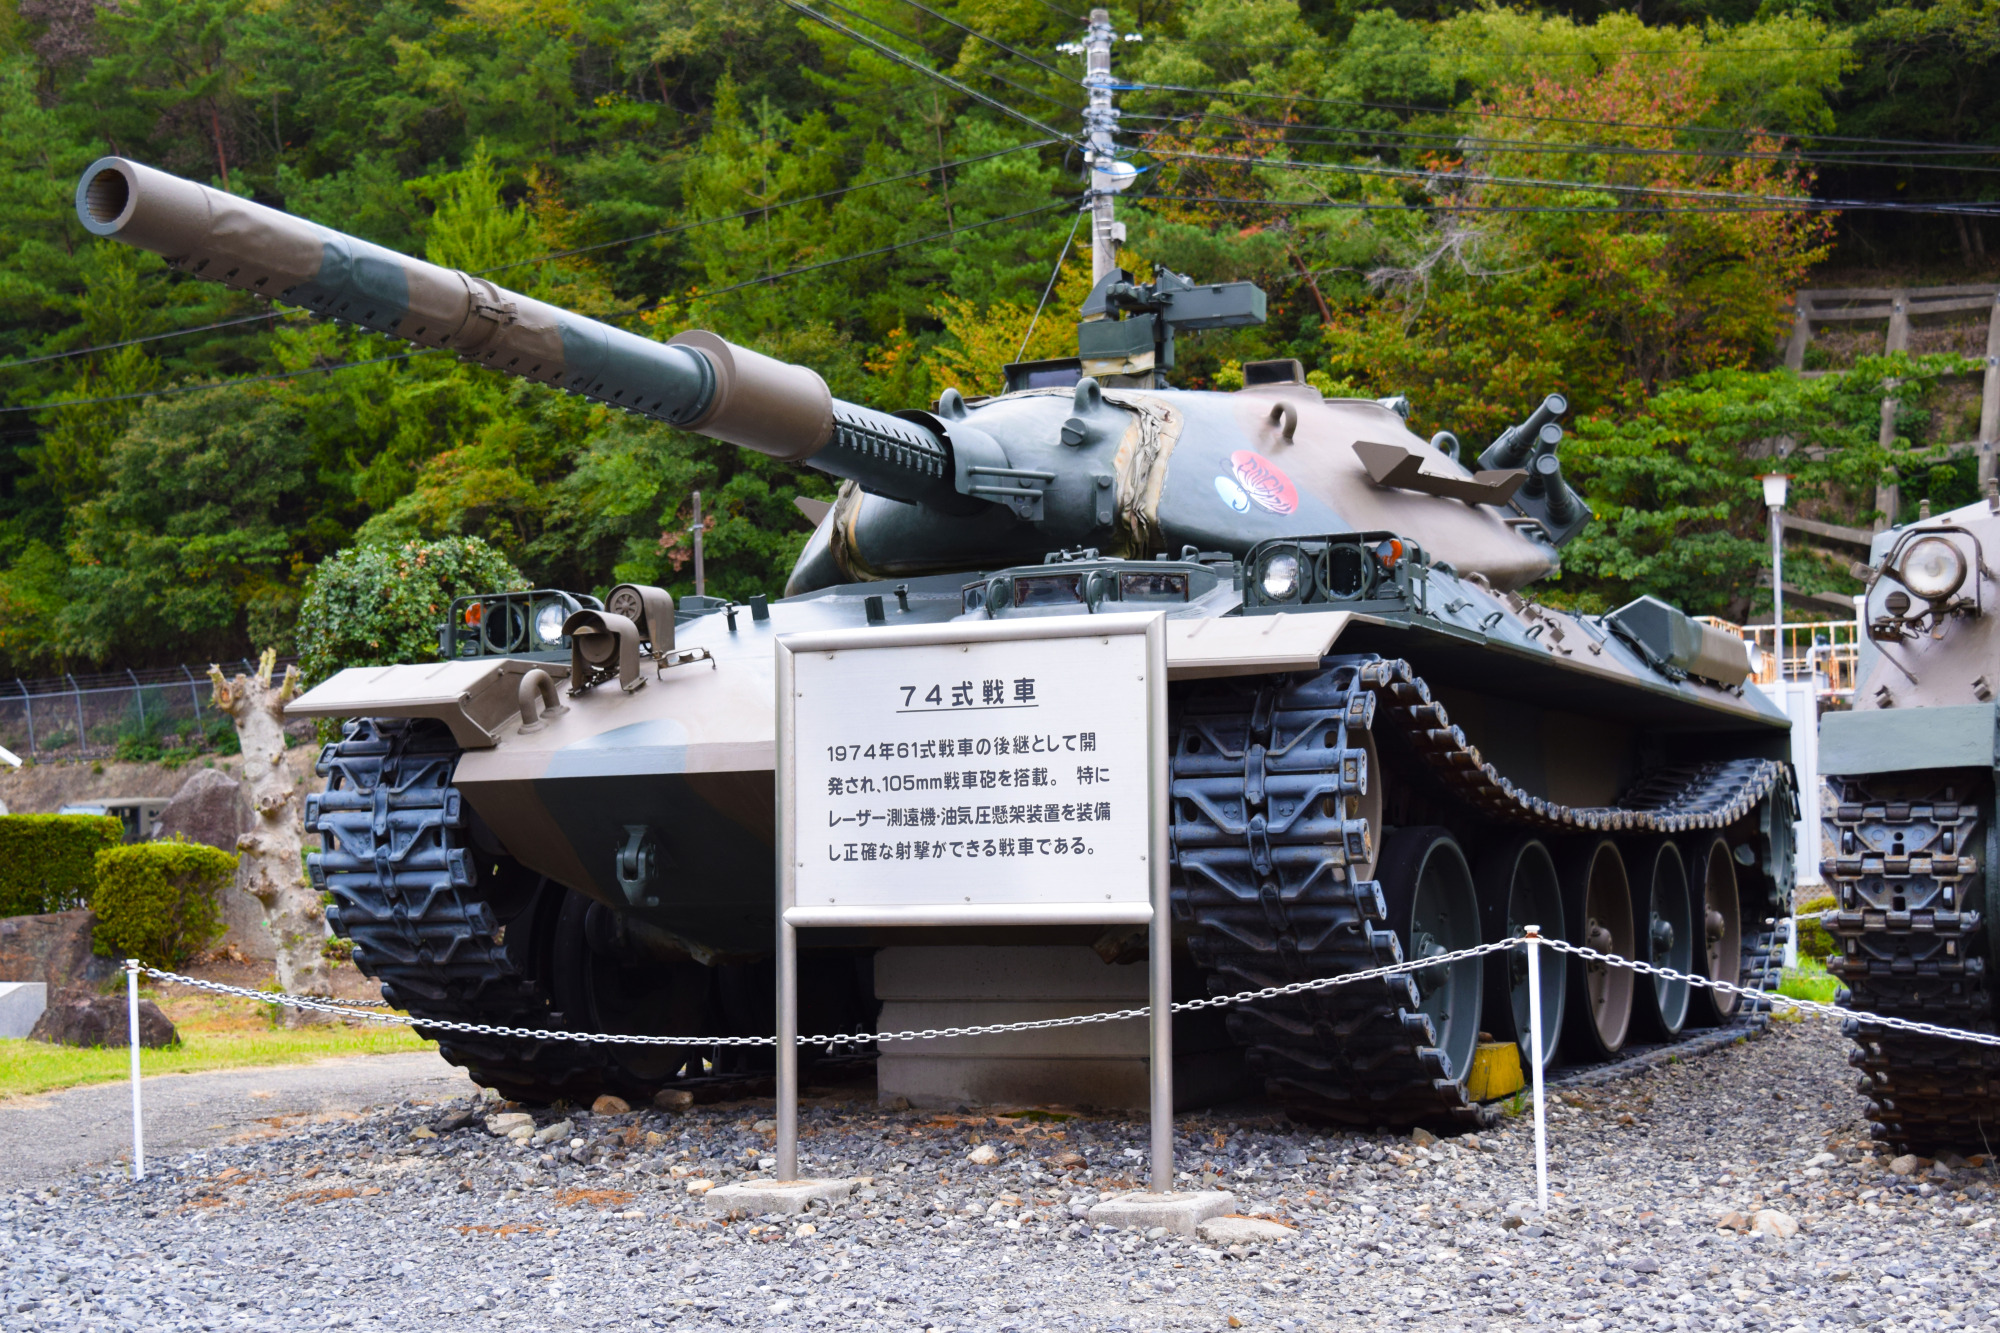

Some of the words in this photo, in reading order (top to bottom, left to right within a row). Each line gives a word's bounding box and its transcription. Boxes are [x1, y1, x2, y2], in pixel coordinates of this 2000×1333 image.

[899, 677, 1037, 707] 74式戦車
[827, 732, 1096, 762] 1974年61式戦車の後継として開
[828, 767, 1057, 796] 発され、105mm戦車砲を搭載。
[1076, 765, 1110, 785] 特に
[829, 836, 1094, 862] し正確な射撃ができる戦車である。
